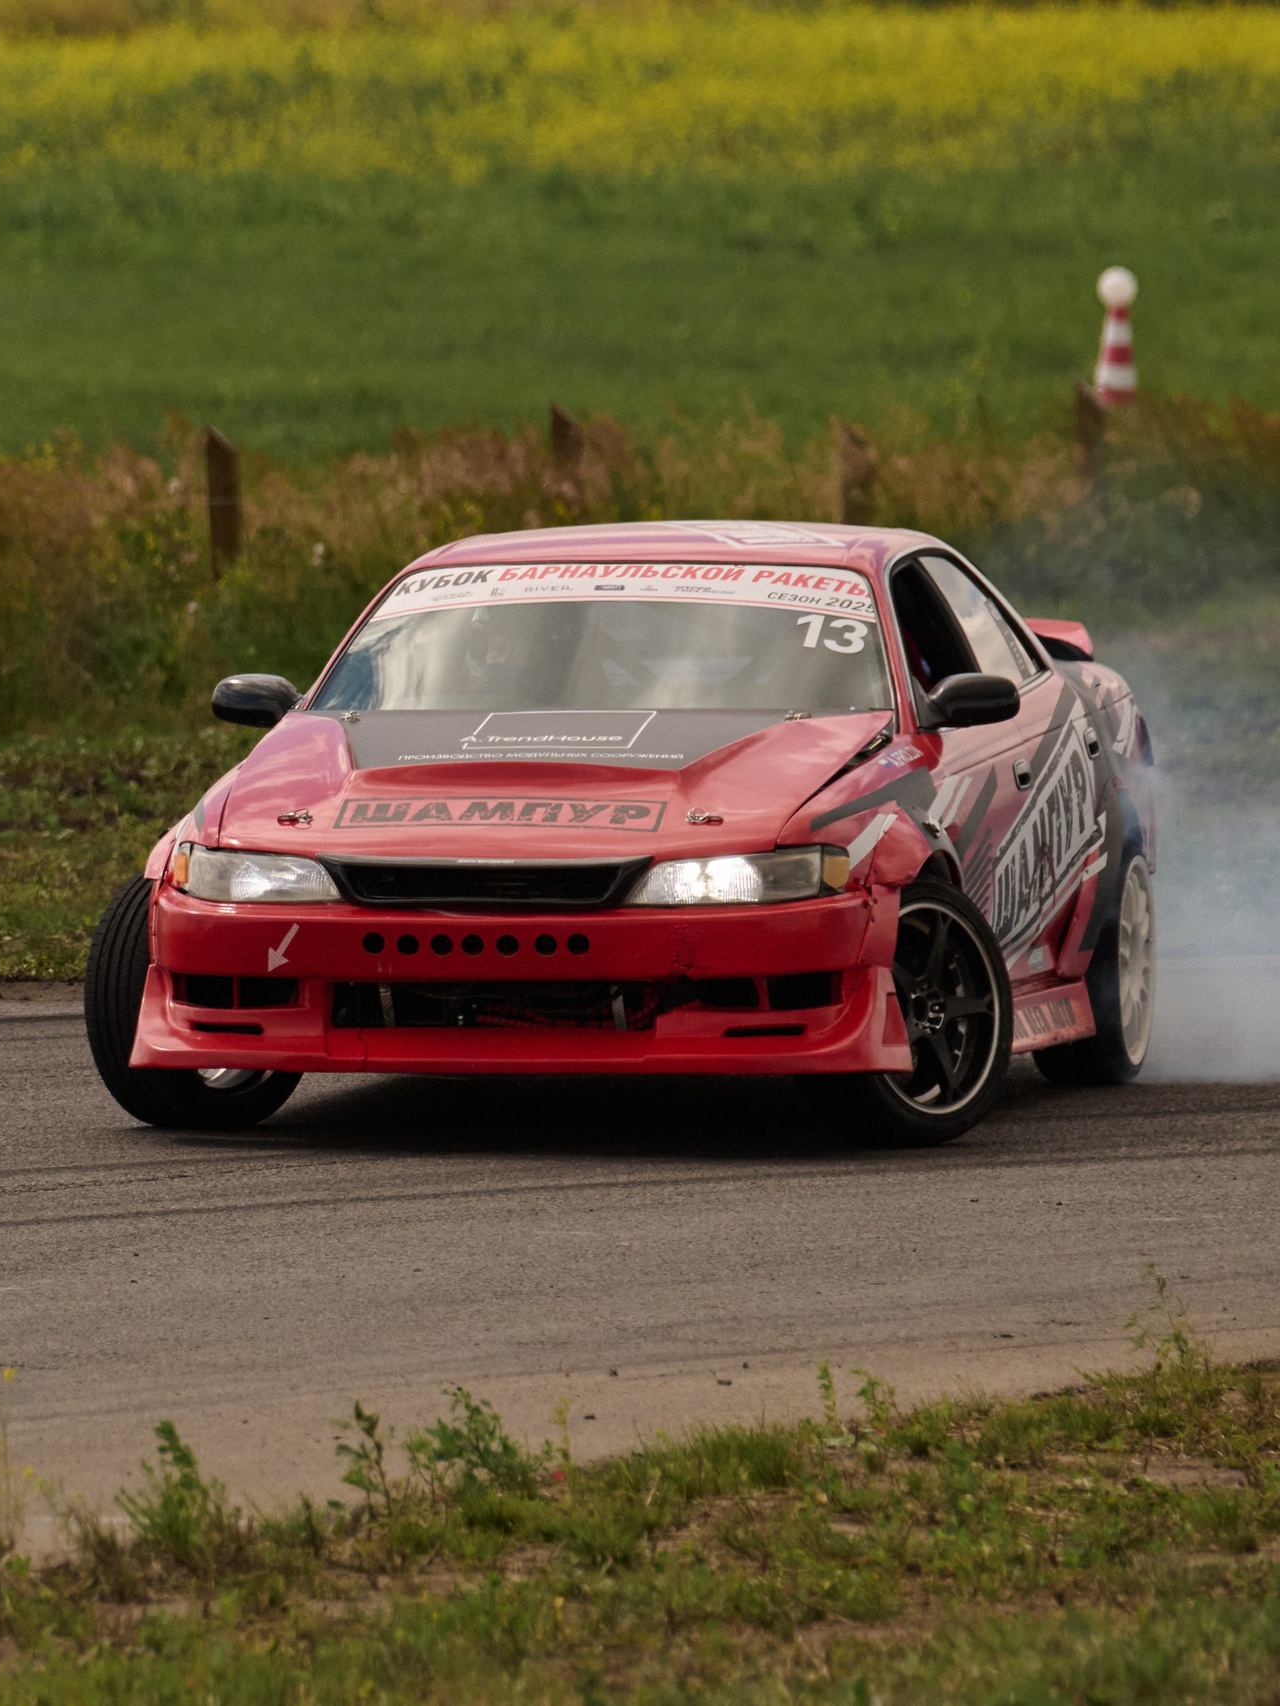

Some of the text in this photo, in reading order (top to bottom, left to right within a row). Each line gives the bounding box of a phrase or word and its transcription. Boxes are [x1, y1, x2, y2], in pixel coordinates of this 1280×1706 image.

[394, 570, 495, 597] КУБОК
[498, 564, 746, 582] БАРНАУЛЬСКОЙ
[767, 591, 821, 605] СЕЗОН
[796, 613, 869, 655] 13
[486, 735, 623, 743] TrendHouse
[397, 751, 685, 762] ПРОИЗВОДСТВО МОДУЛЬНЫХ СООРУЖЕНИЙ
[349, 801, 651, 826] ШАМПУР
[995, 749, 1088, 941] ШАМПУР
